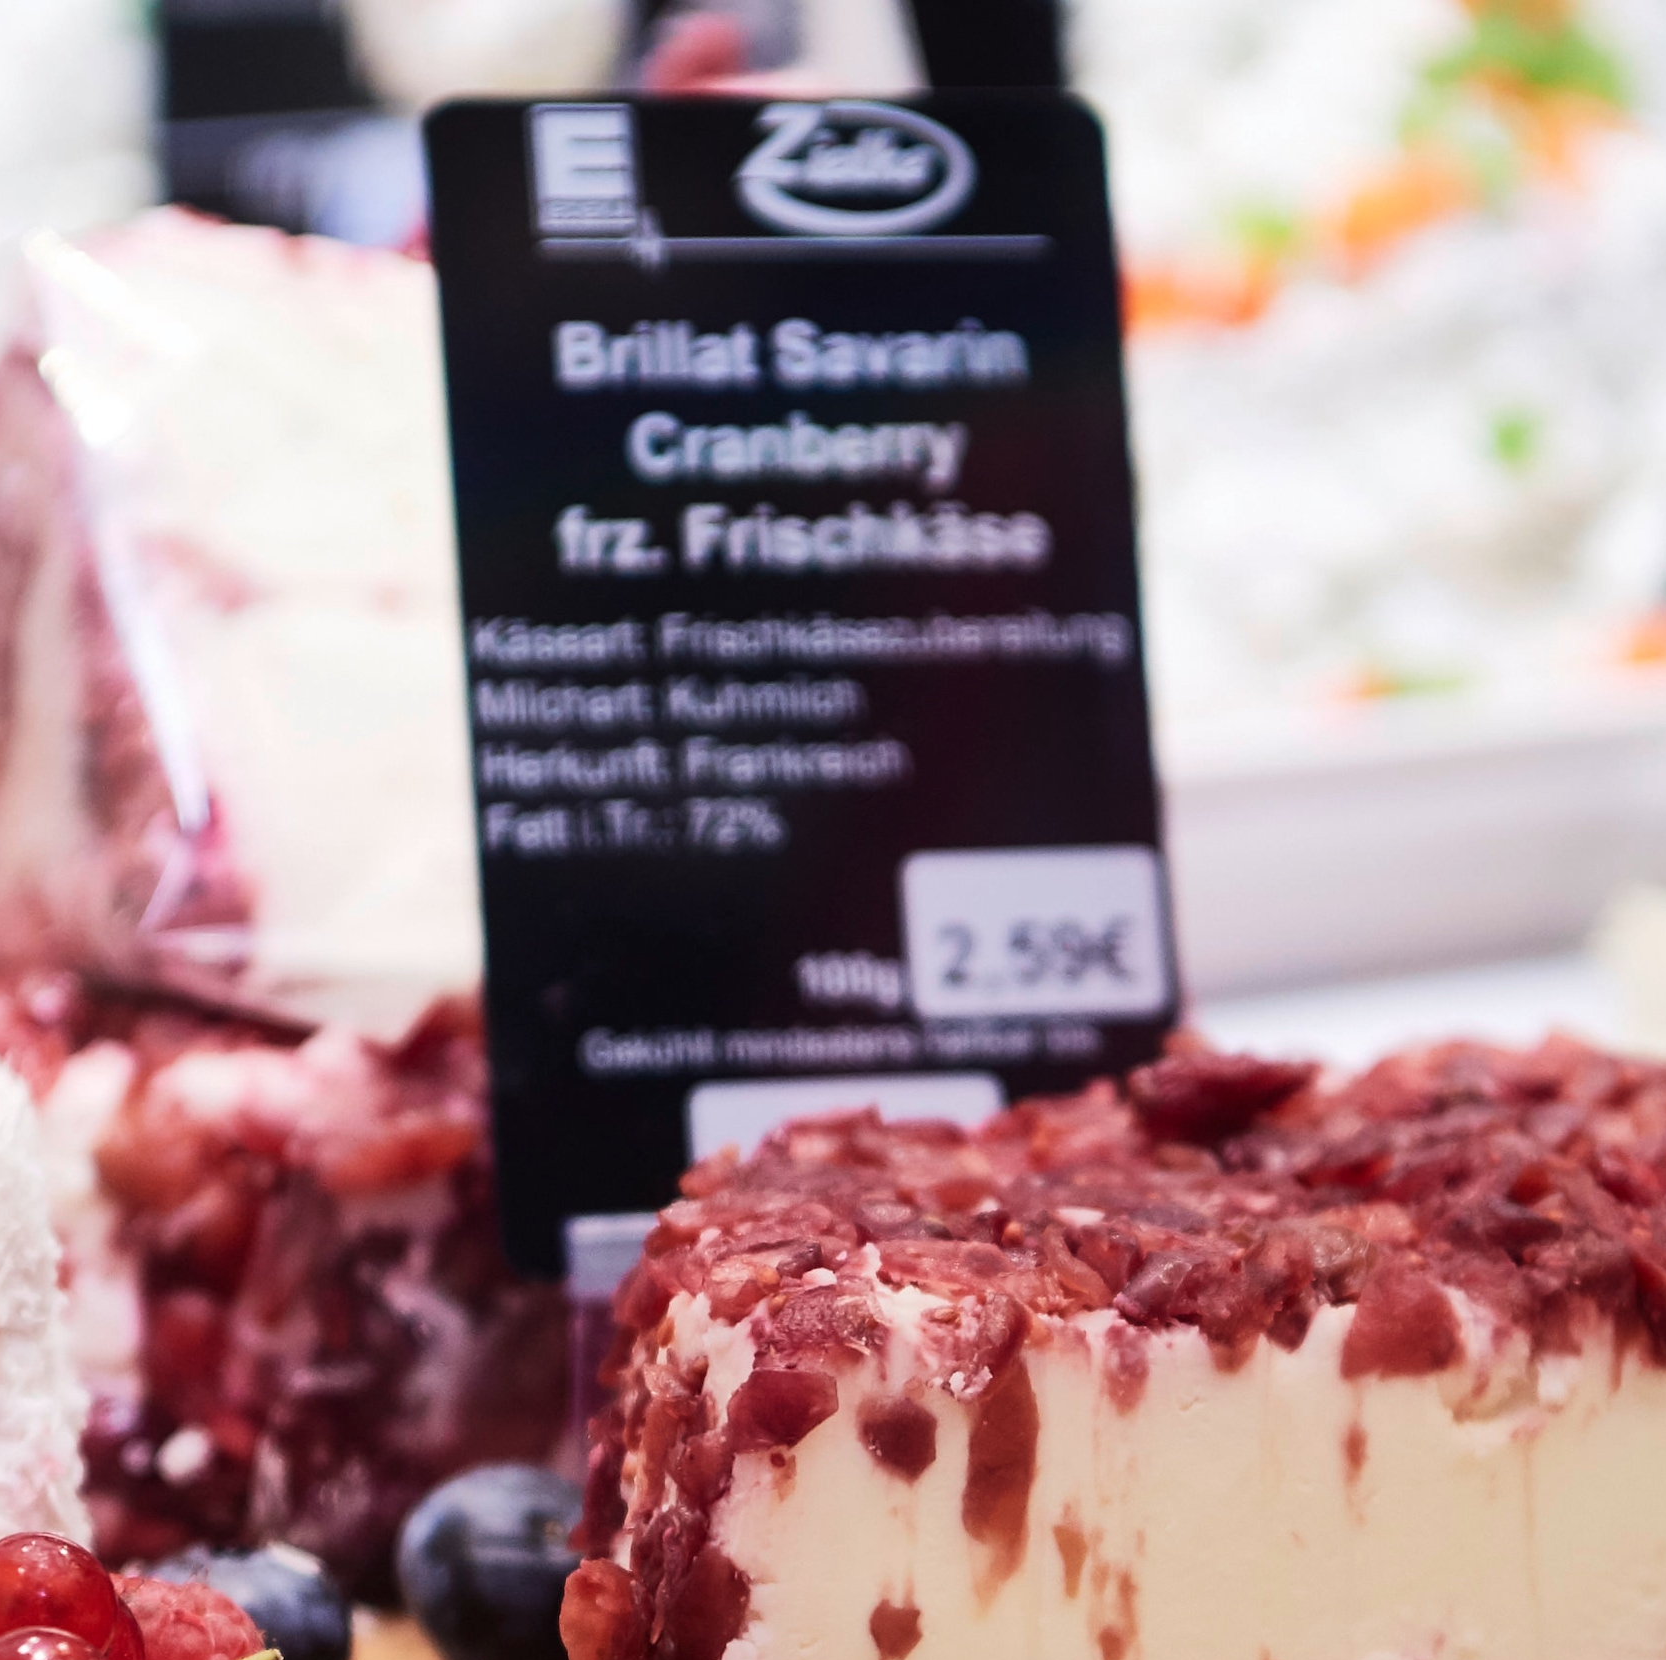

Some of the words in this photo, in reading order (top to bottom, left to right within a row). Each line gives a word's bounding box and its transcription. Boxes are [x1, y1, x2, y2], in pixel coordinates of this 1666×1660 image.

[553, 318, 760, 390] Brillat
[770, 316, 1031, 388] Savarin
[627, 409, 969, 490] Cranberry
[553, 504, 669, 574] frz.
[681, 500, 1053, 572] Frischkäse
